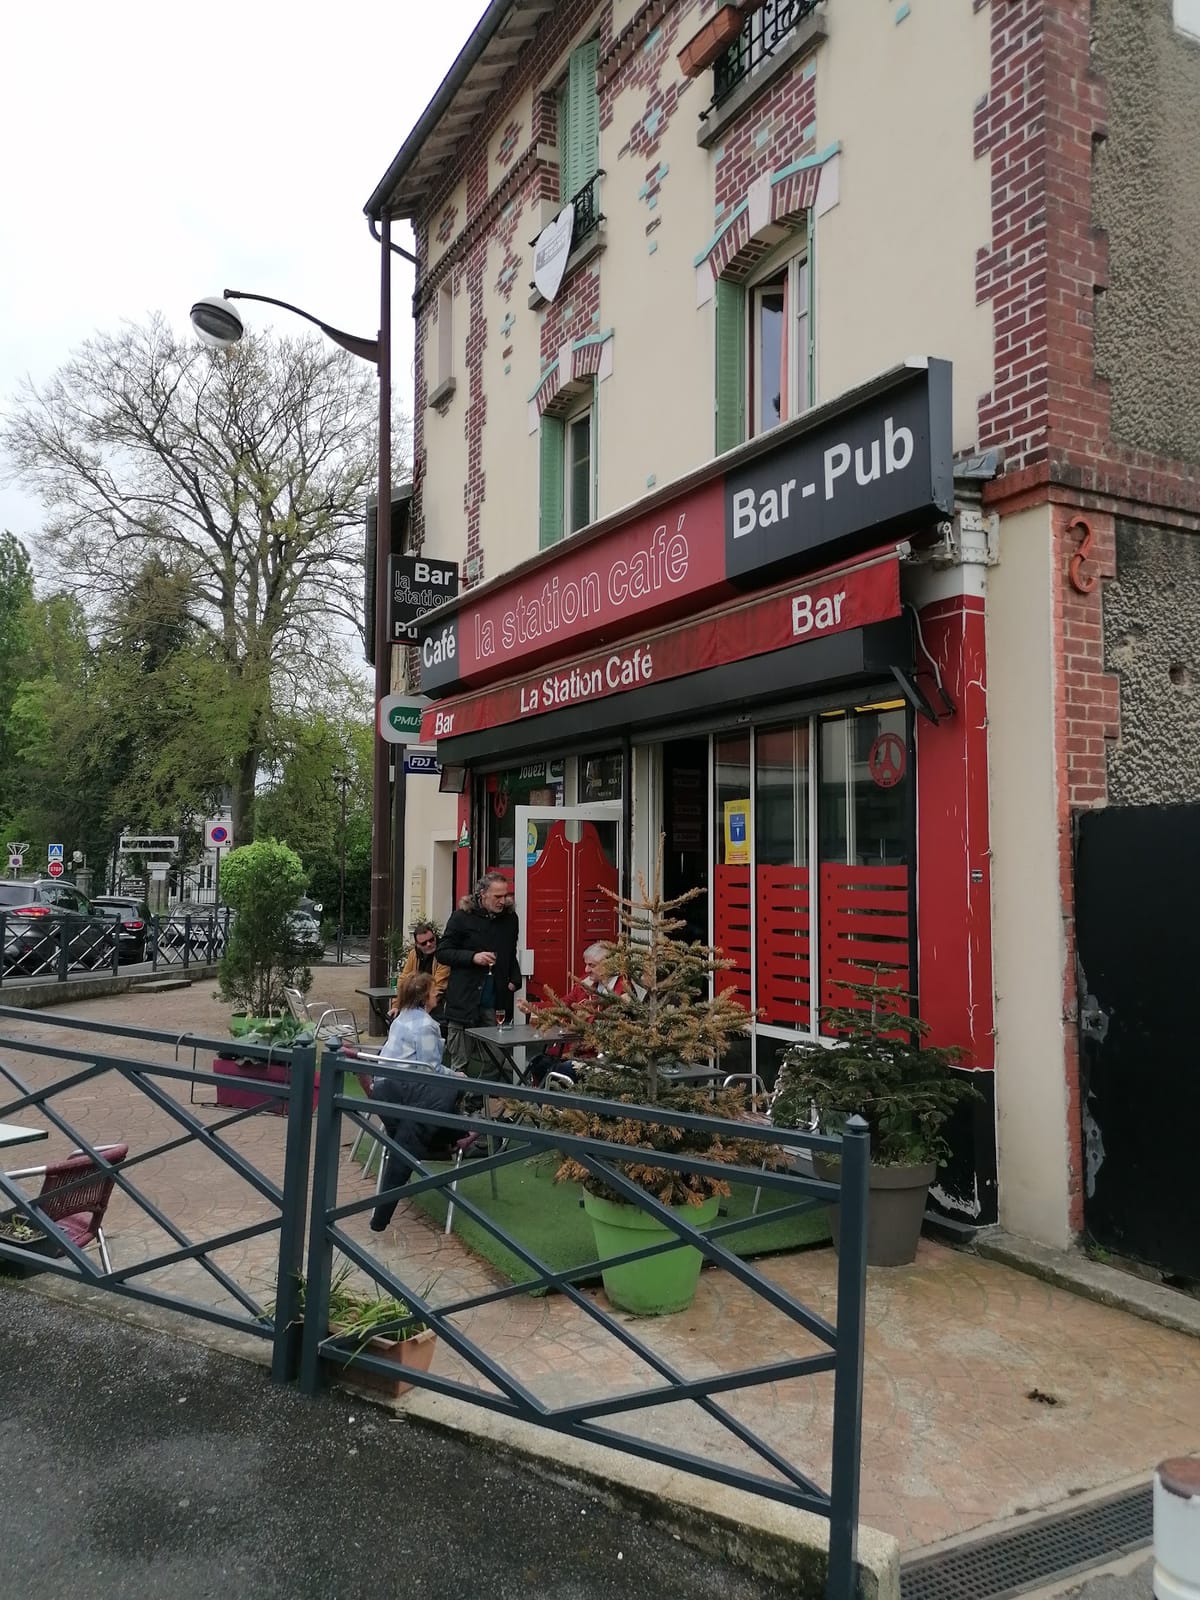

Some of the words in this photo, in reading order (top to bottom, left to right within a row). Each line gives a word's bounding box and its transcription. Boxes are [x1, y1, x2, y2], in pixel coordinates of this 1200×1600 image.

[733, 478, 796, 539] Bar
[823, 416, 914, 501] Pub
[394, 570, 411, 589] la
[414, 562, 453, 586] Bar
[475, 614, 496, 660] la
[502, 571, 600, 649] station
[608, 513, 689, 605] café
[791, 591, 846, 636] Bar
[395, 621, 418, 639] Pu
[423, 626, 456, 668] Café
[520, 687, 539, 713] La
[542, 668, 603, 706] Station
[605, 644, 653, 688] Café
[393, 715, 418, 726] PMU
[434, 712, 455, 736] Bar
[411, 757, 431, 767] FDJ
